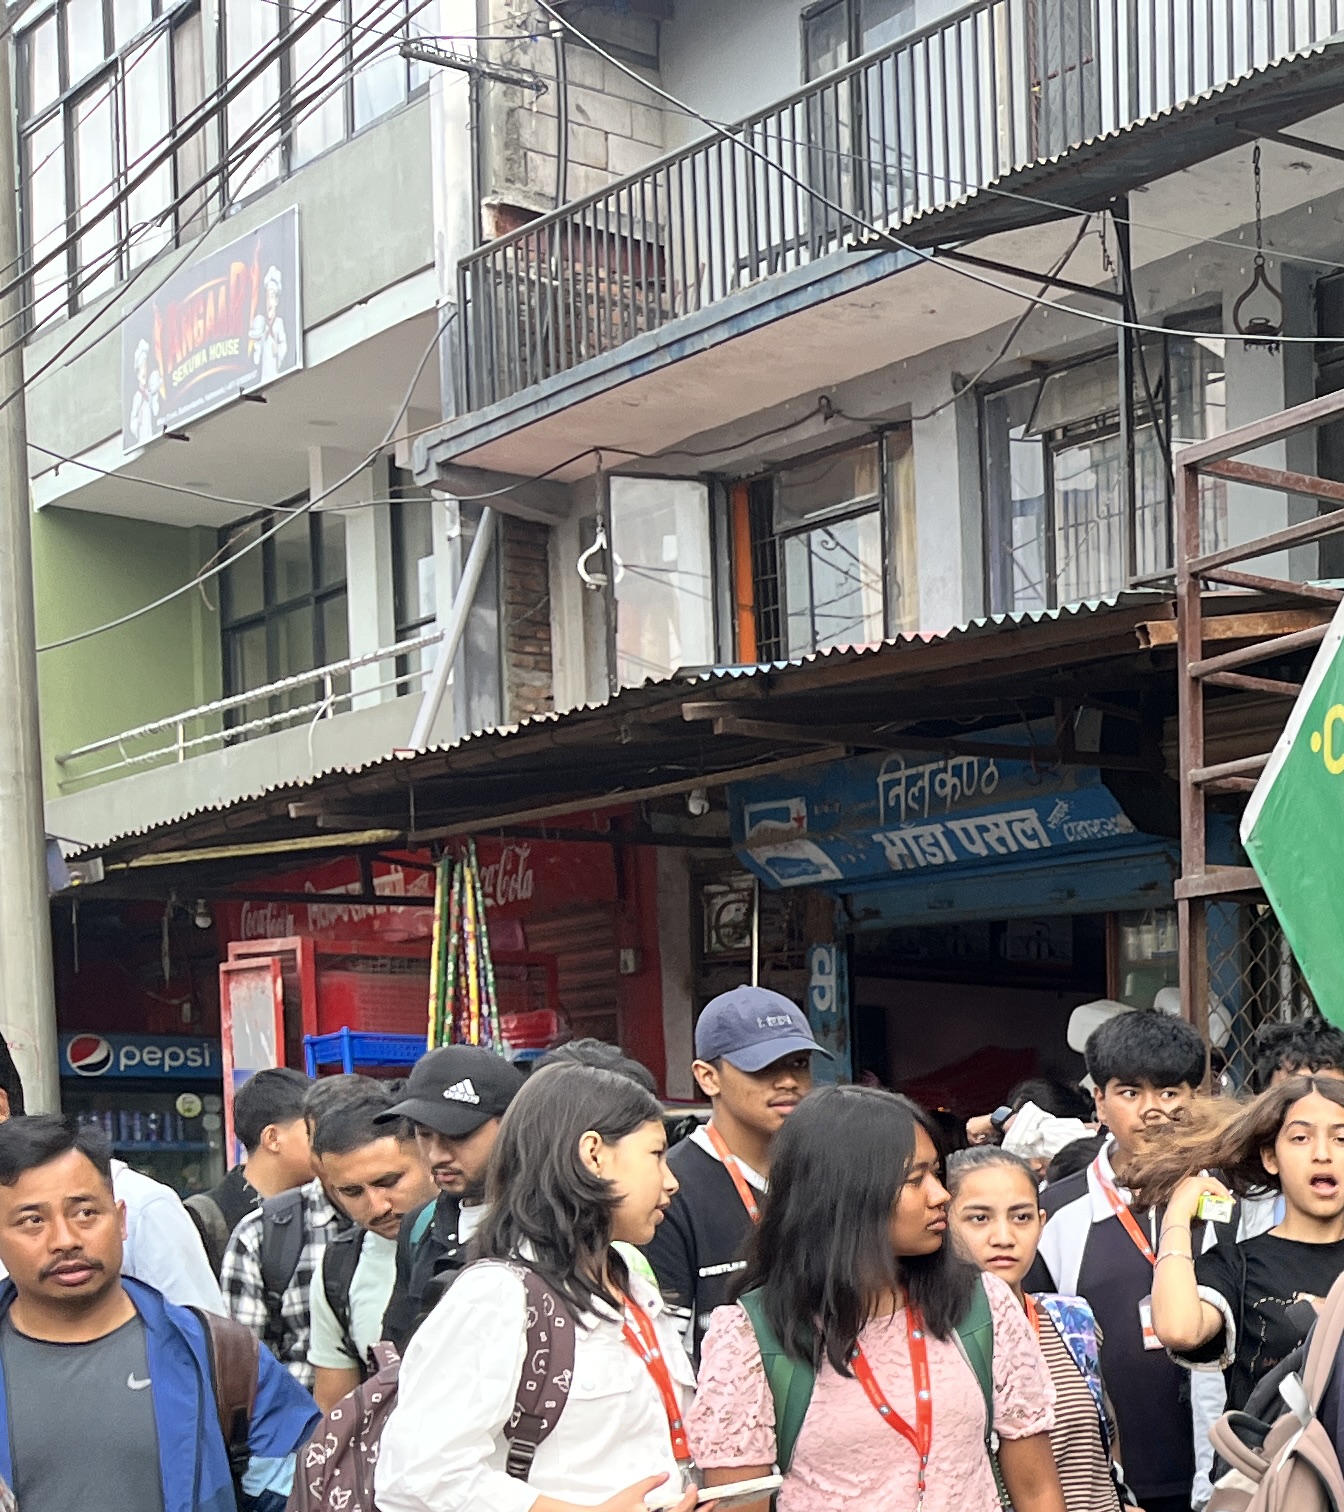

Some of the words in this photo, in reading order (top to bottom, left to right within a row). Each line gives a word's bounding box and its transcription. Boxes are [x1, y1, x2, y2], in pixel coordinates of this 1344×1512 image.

[172, 348, 207, 387] SEKUWA
[208, 338, 240, 361] HOUSE
[944, 808, 1053, 857] पसल
[119, 1043, 210, 1072] pepsi
